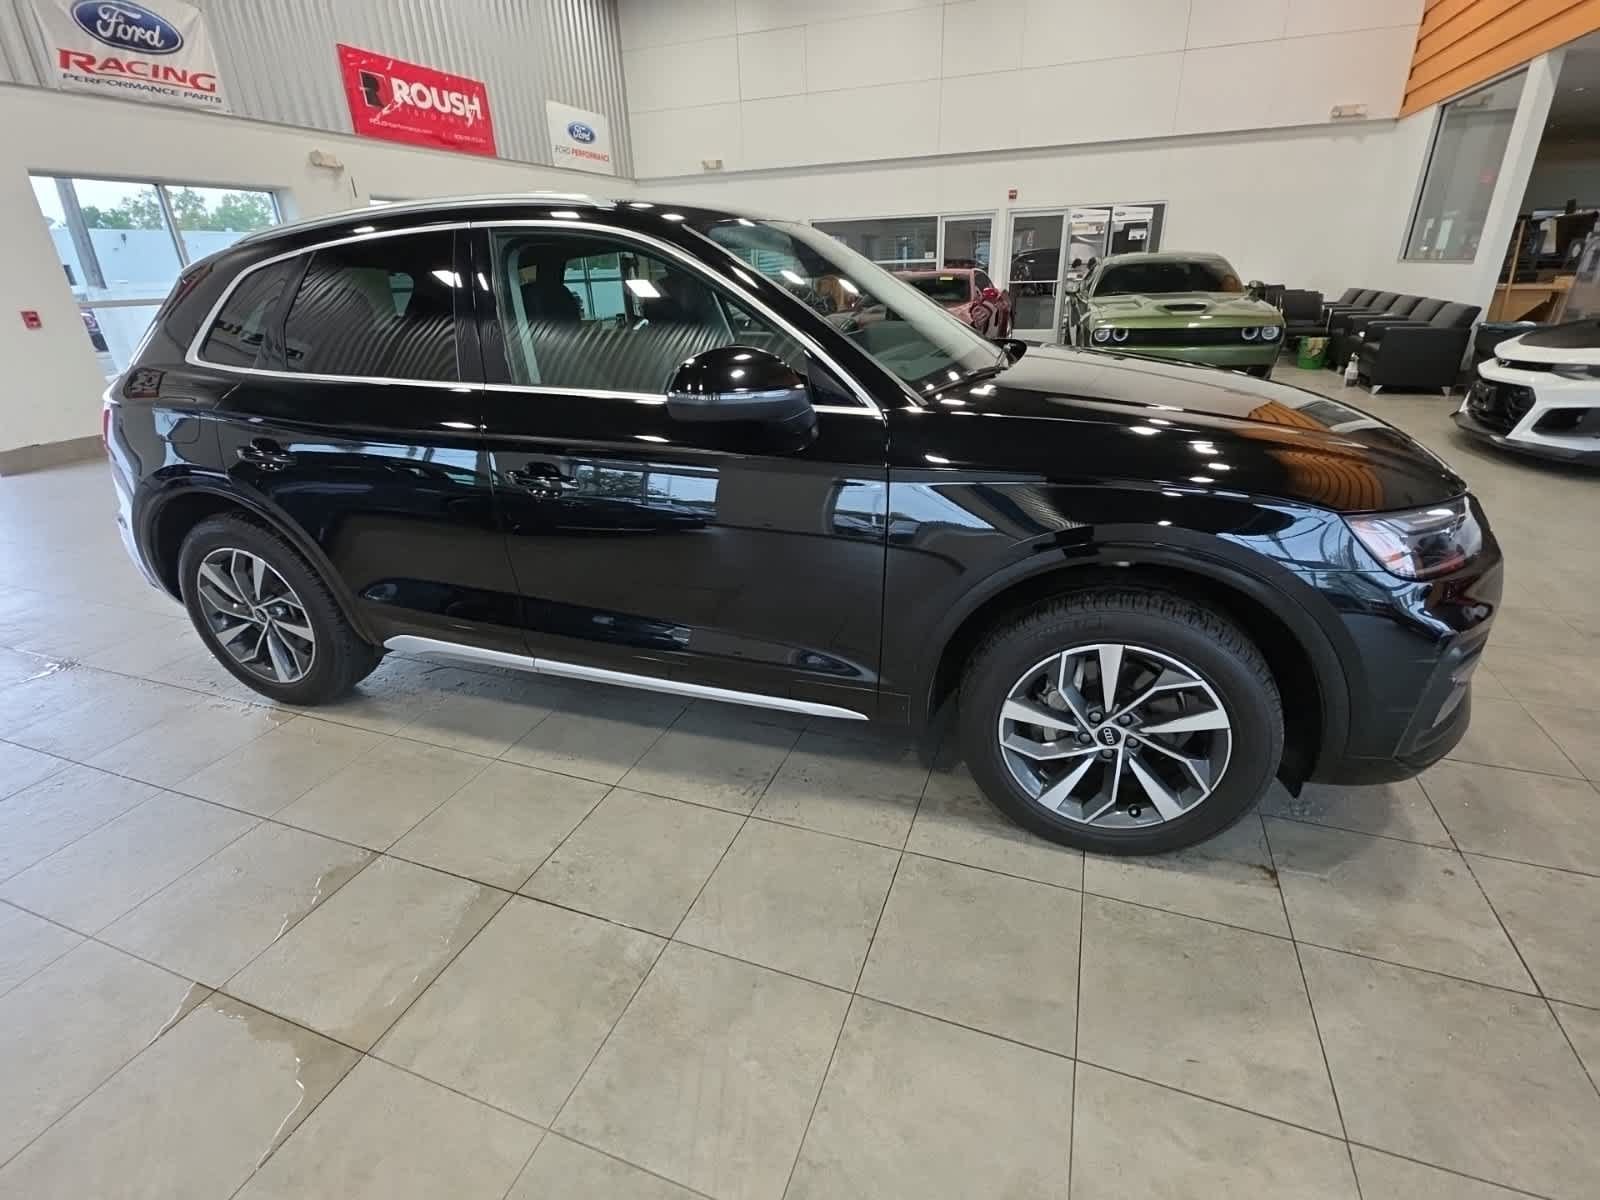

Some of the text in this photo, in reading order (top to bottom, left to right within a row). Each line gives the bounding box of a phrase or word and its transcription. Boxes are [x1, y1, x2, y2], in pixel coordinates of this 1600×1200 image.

[96, 4, 164, 48] Ford
[56, 48, 217, 93] RACING
[63, 73, 222, 104] PERFORMANCE PARTS
[390, 76, 482, 124] ROUSH
